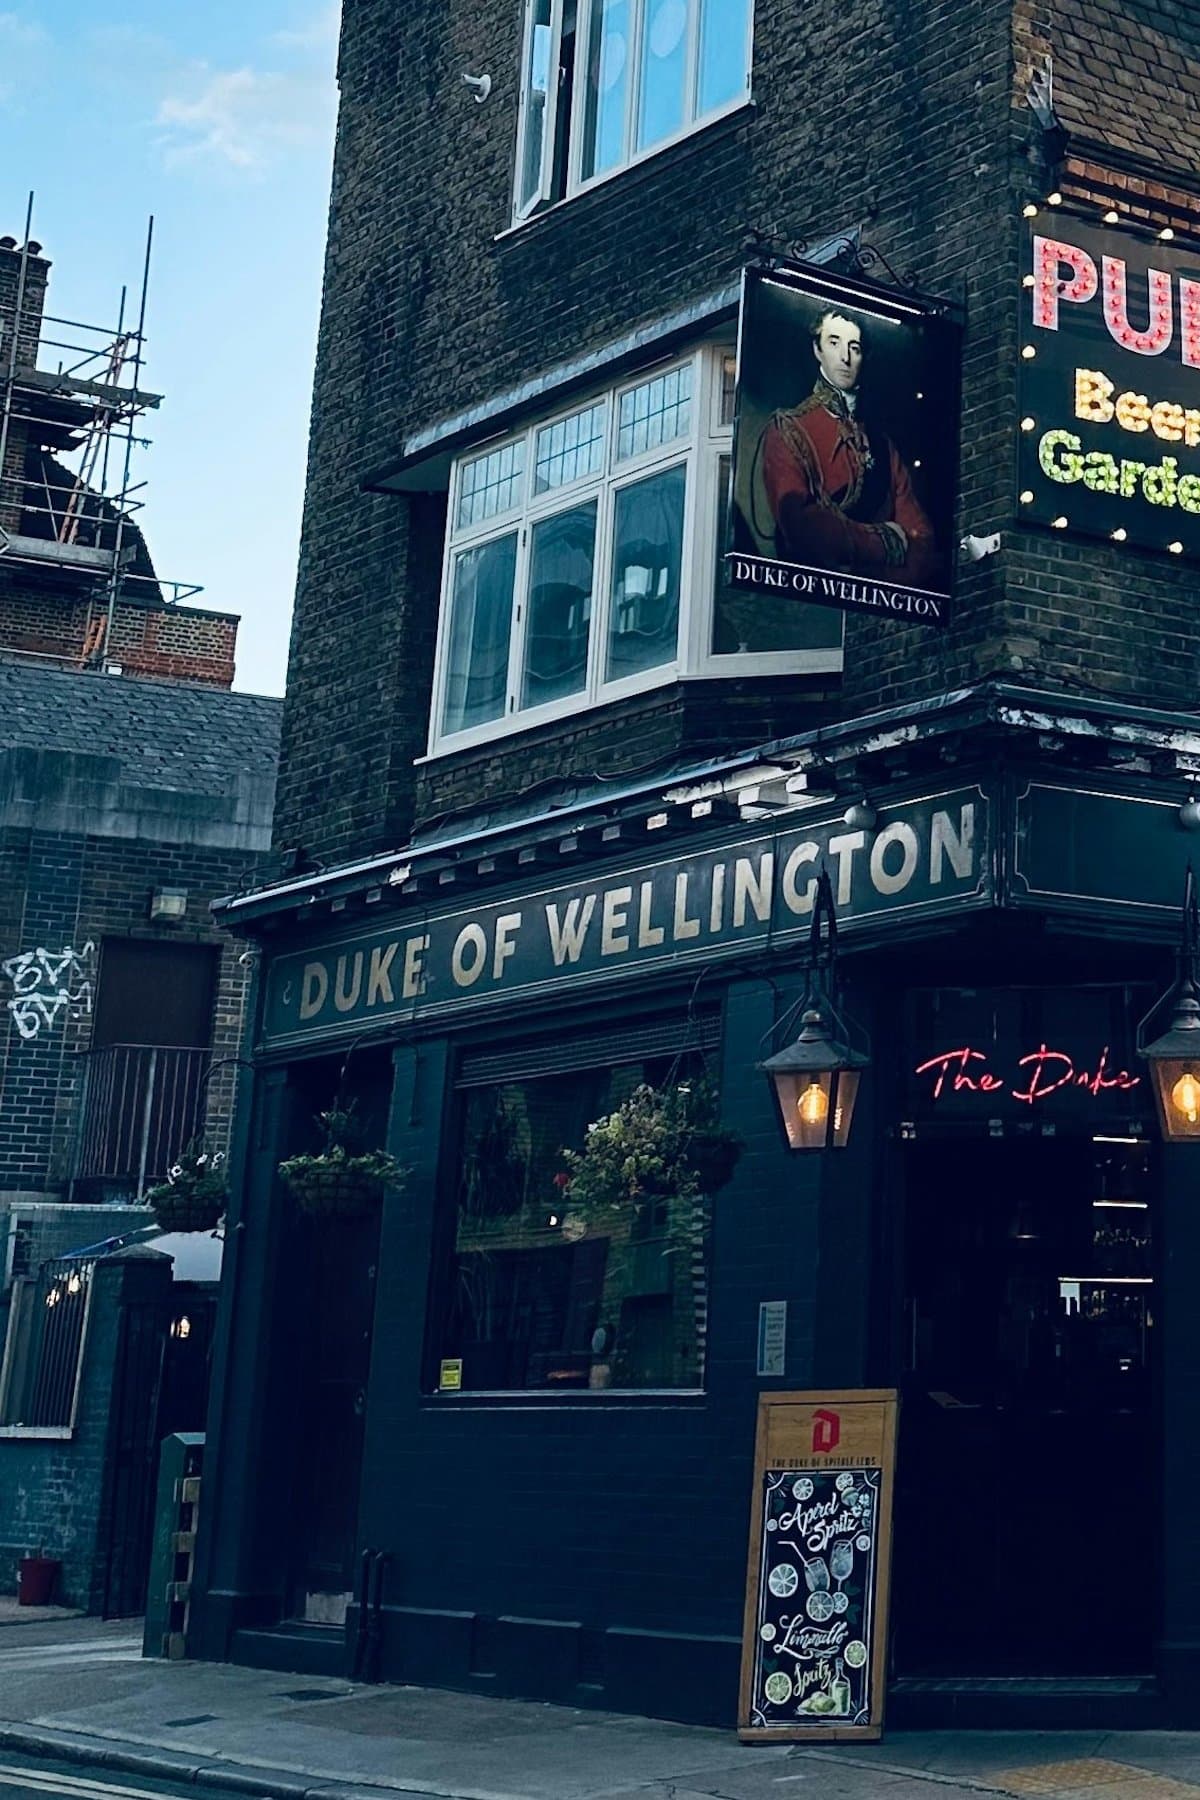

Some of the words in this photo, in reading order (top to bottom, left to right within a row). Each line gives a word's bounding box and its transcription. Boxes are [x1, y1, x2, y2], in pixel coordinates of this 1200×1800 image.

[735, 560, 789, 587] DUKE
[792, 571, 818, 593] OF
[822, 576, 942, 618] WELLINGTON
[299, 934, 430, 1021] DUKE
[451, 911, 522, 988] OF
[545, 802, 976, 967] WELLINGTON
[915, 1047, 1004, 1099] The
[1011, 1043, 1142, 1105] Duke
[778, 1491, 840, 1538] Aperol
[806, 1509, 860, 1553] Spritz
